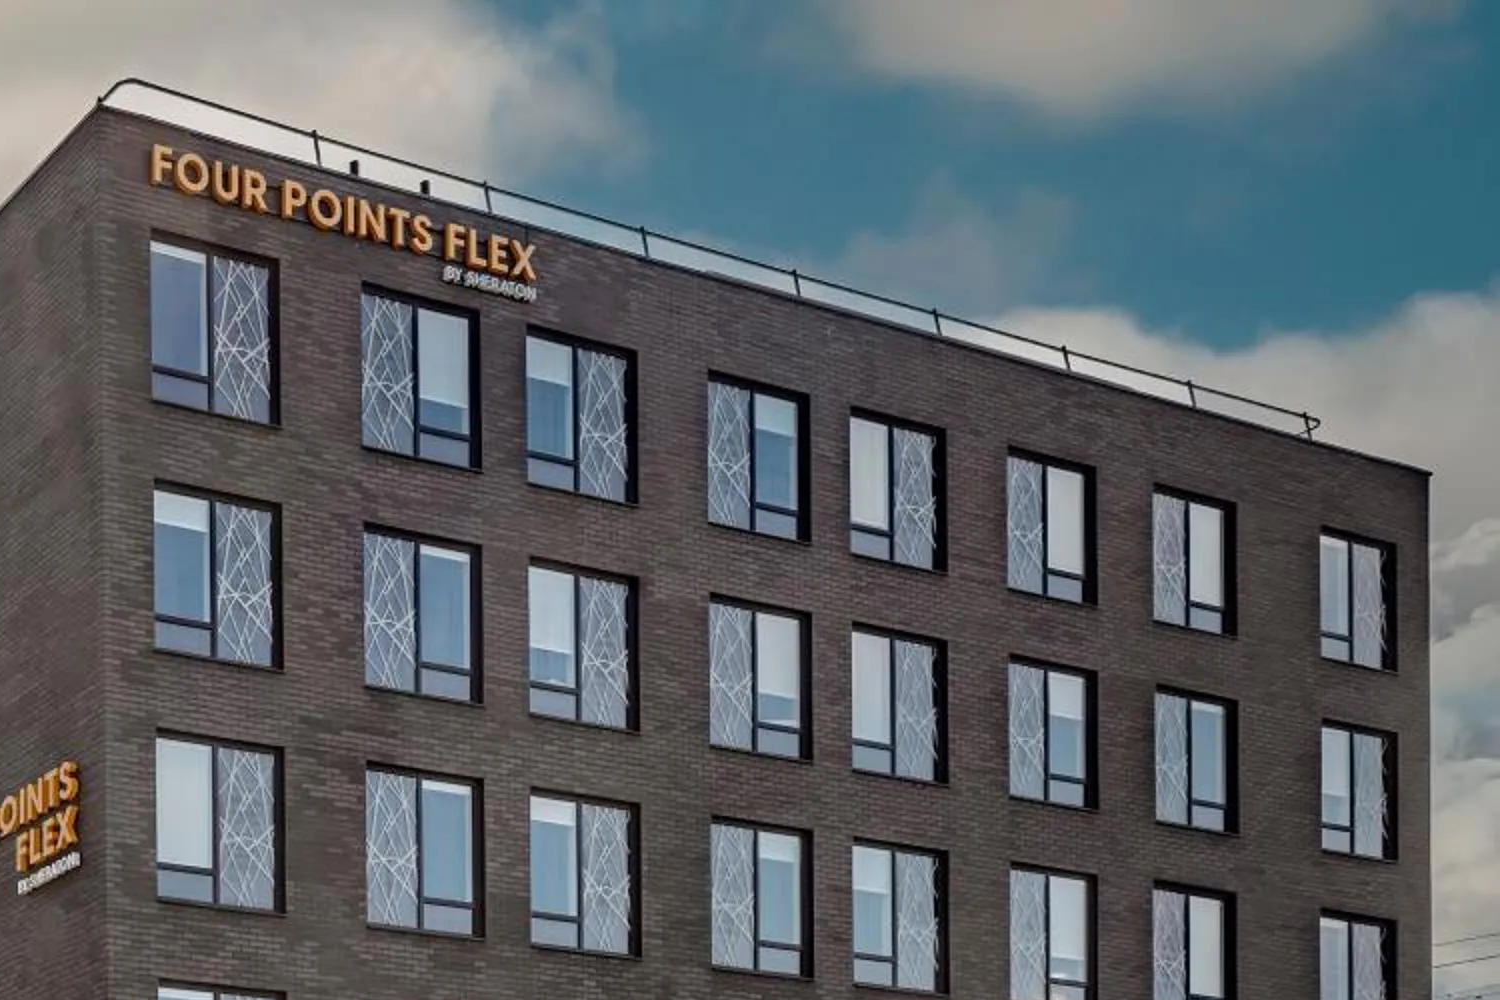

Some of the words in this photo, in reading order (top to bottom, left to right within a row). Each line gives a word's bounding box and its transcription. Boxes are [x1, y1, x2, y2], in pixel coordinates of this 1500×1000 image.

[149, 143, 268, 216] FOUR
[280, 178, 433, 255] POINTS
[444, 221, 537, 281] FLEX
[443, 265, 463, 284] BY
[464, 270, 537, 302] SHERATON
[16, 804, 79, 874] FLEX
